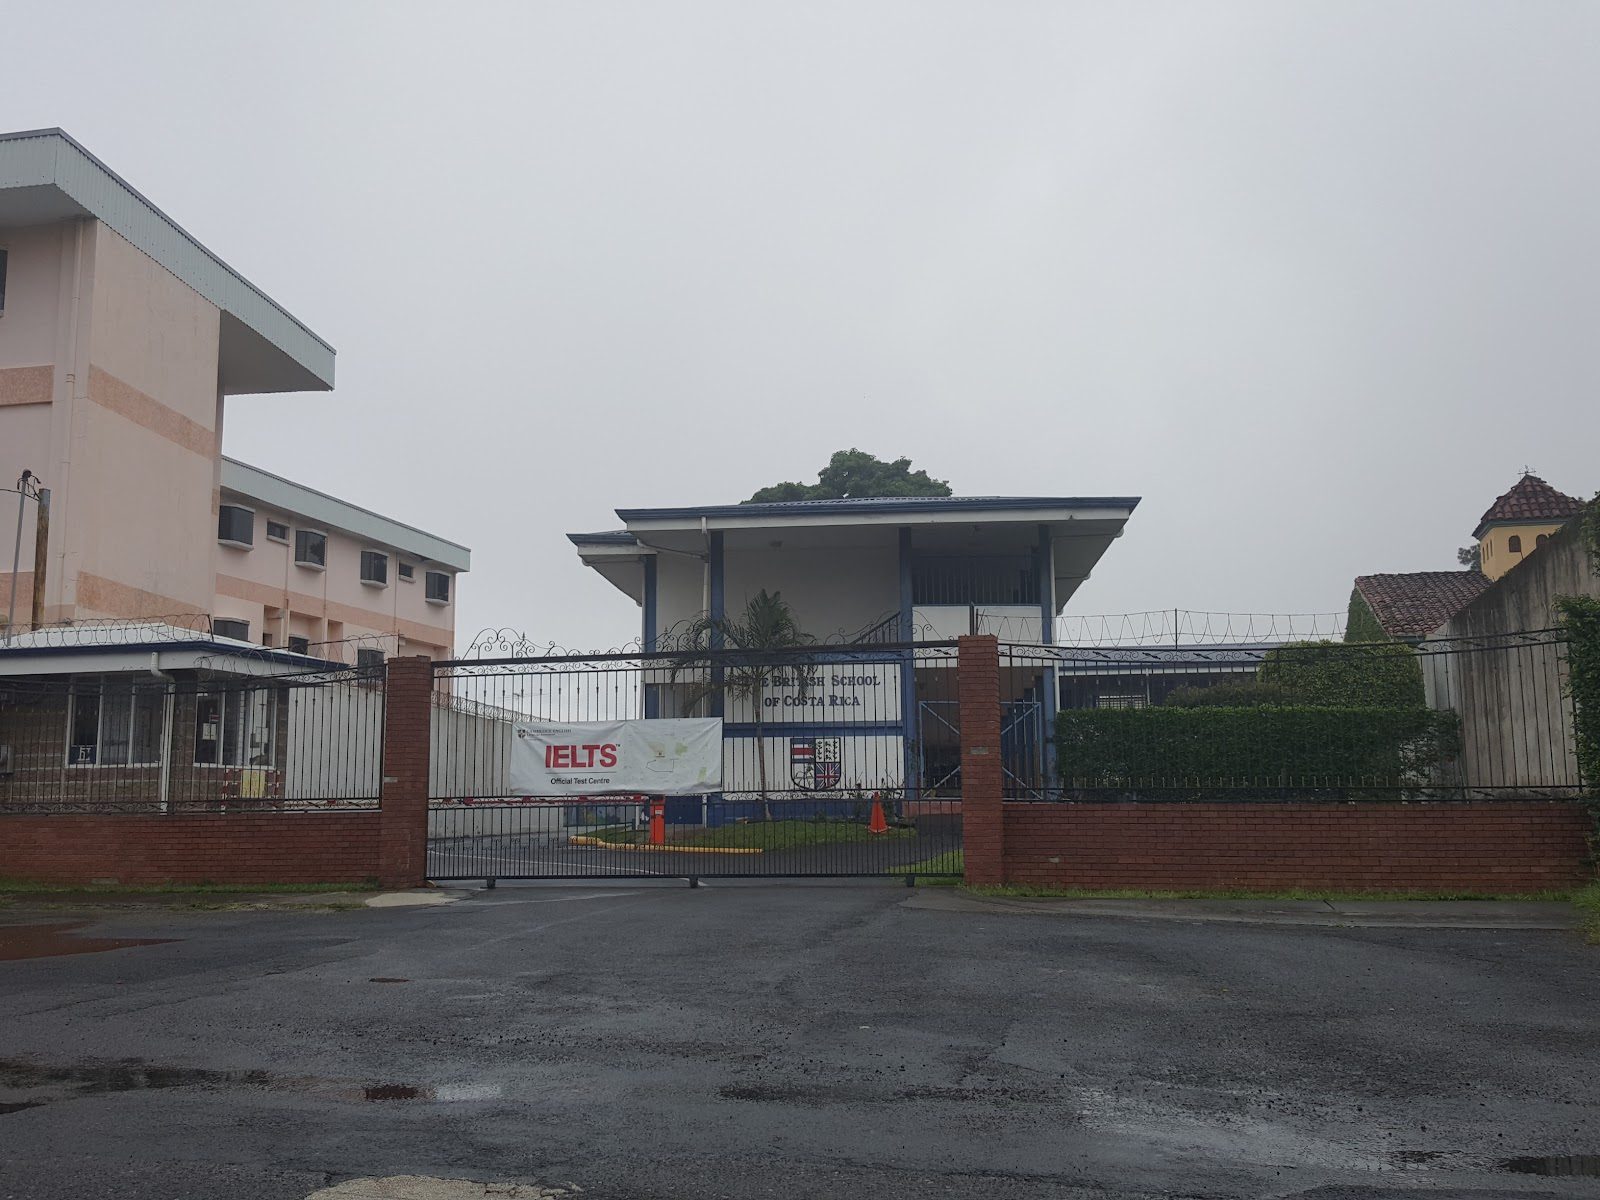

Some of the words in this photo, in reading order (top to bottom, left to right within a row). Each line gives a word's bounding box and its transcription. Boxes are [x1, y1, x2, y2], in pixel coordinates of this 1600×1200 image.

[772, 675, 826, 687] BRISH
[831, 675, 881, 687] SCHOOL
[764, 697, 781, 707] OF
[784, 695, 826, 707] COSTA
[828, 694, 861, 707] RICA
[550, 777, 573, 785] Official
[573, 777, 587, 785] Test
[588, 777, 610, 785] Centre
